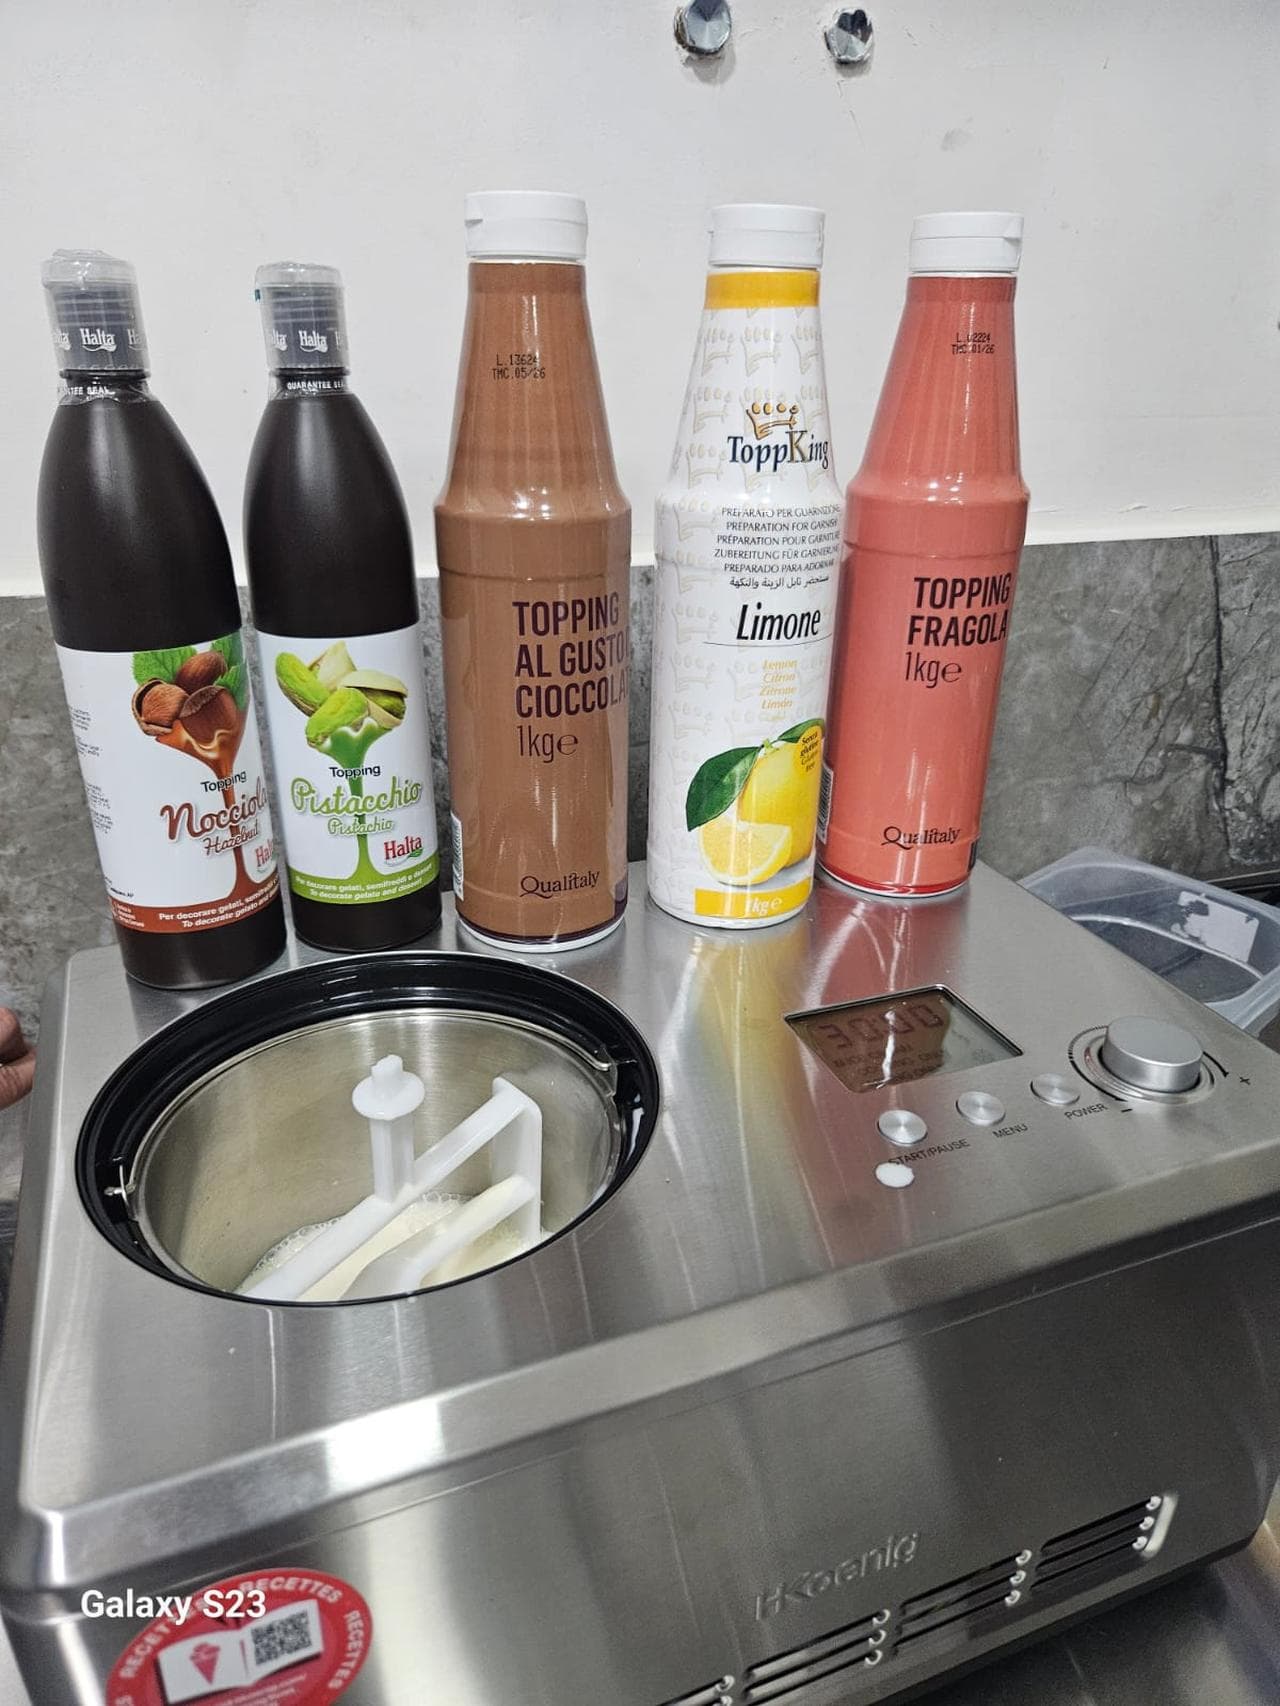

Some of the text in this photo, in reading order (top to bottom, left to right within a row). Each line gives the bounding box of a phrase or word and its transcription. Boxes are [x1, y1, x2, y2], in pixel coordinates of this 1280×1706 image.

[80, 327, 117, 348] Halta
[298, 329, 328, 348] Halta
[727, 430, 829, 473] ToppKing
[722, 507, 775, 518] PREPARATO
[777, 508, 793, 518] PER
[726, 521, 789, 531] PREPARATION
[791, 521, 809, 531] FOR
[717, 533, 779, 546] PRÉPARATION
[782, 535, 806, 546] POUR
[714, 548, 780, 560] ZUBEREITUNG
[782, 548, 799, 560] FÜR
[724, 563, 779, 573] PREPARADO
[781, 564, 802, 573] PARA
[914, 572, 1012, 609] TOPPING
[512, 592, 619, 636] TOPPING
[736, 602, 821, 640] Limone
[907, 609, 1008, 647] FRAGOLA
[514, 644, 552, 678] AL
[559, 631, 624, 677] GUSTO
[201, 770, 247, 793] Topping
[329, 764, 381, 779] Topping
[291, 776, 422, 816] Pistacchio
[327, 816, 394, 837] Pistachio
[203, 824, 260, 856] Hazelnut
[383, 835, 422, 860] Halta
[881, 826, 960, 850] Qualitaly
[519, 871, 600, 898] Qualitaly
[159, 912, 174, 921] Per
[176, 908, 217, 921] decorare
[181, 919, 193, 928] To
[195, 911, 234, 926] decorate
[1064, 1102, 1108, 1121] POWER
[992, 1122, 1029, 1139] MENU
